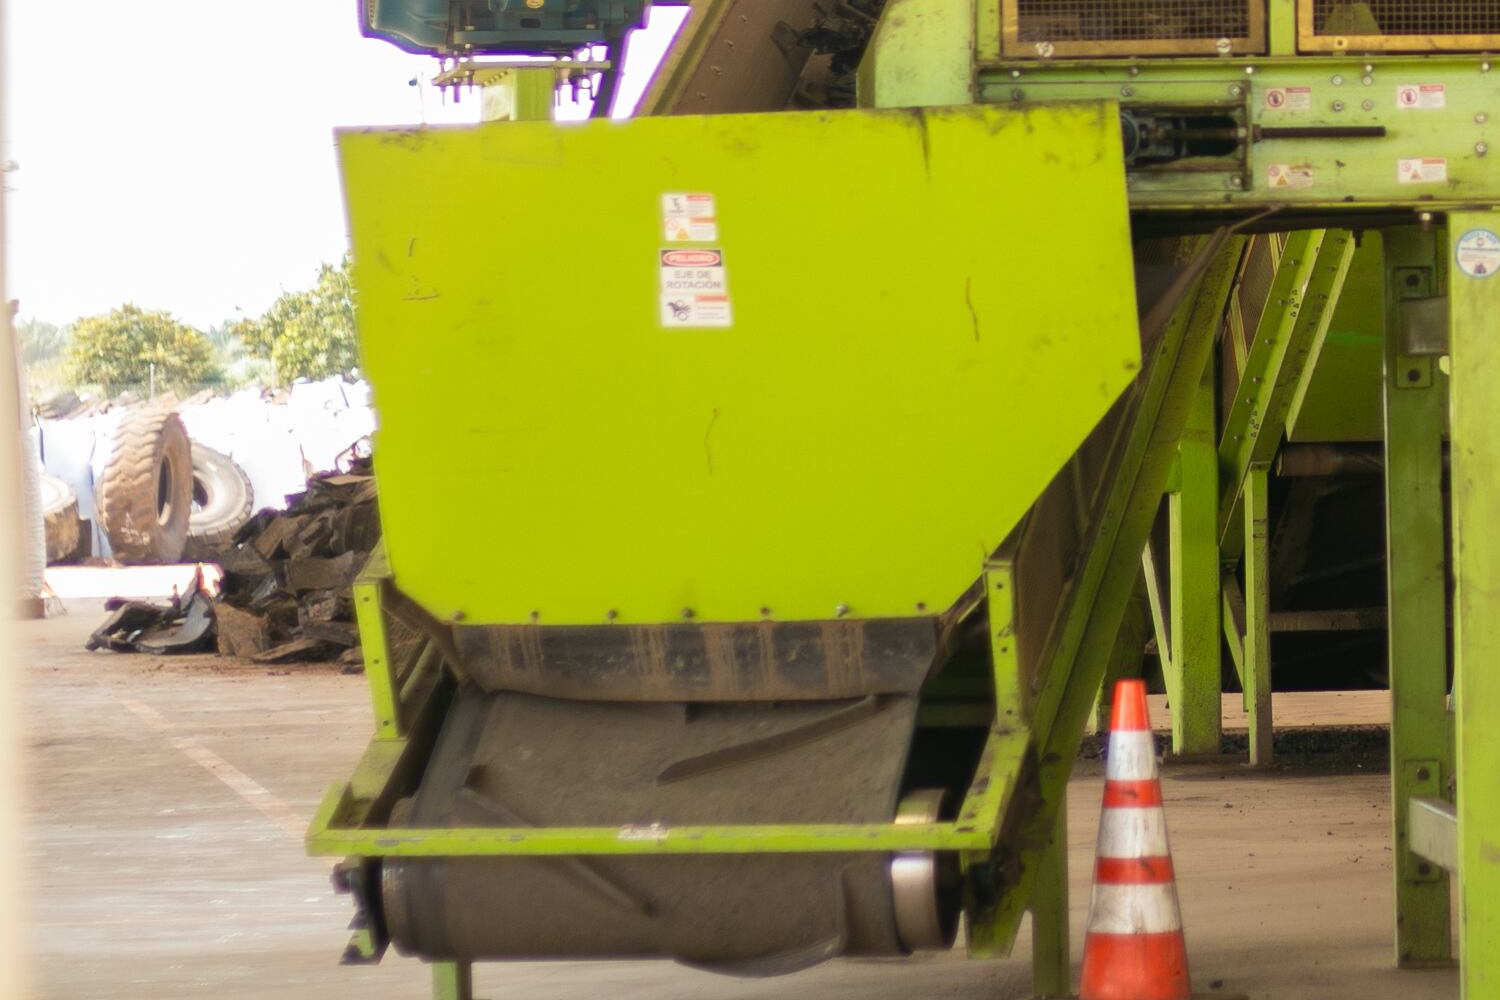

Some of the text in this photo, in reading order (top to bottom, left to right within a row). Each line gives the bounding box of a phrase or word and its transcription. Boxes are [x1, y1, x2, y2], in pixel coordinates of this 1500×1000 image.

[670, 254, 714, 263] PELIGRO
[674, 270, 712, 279] EJE DE
